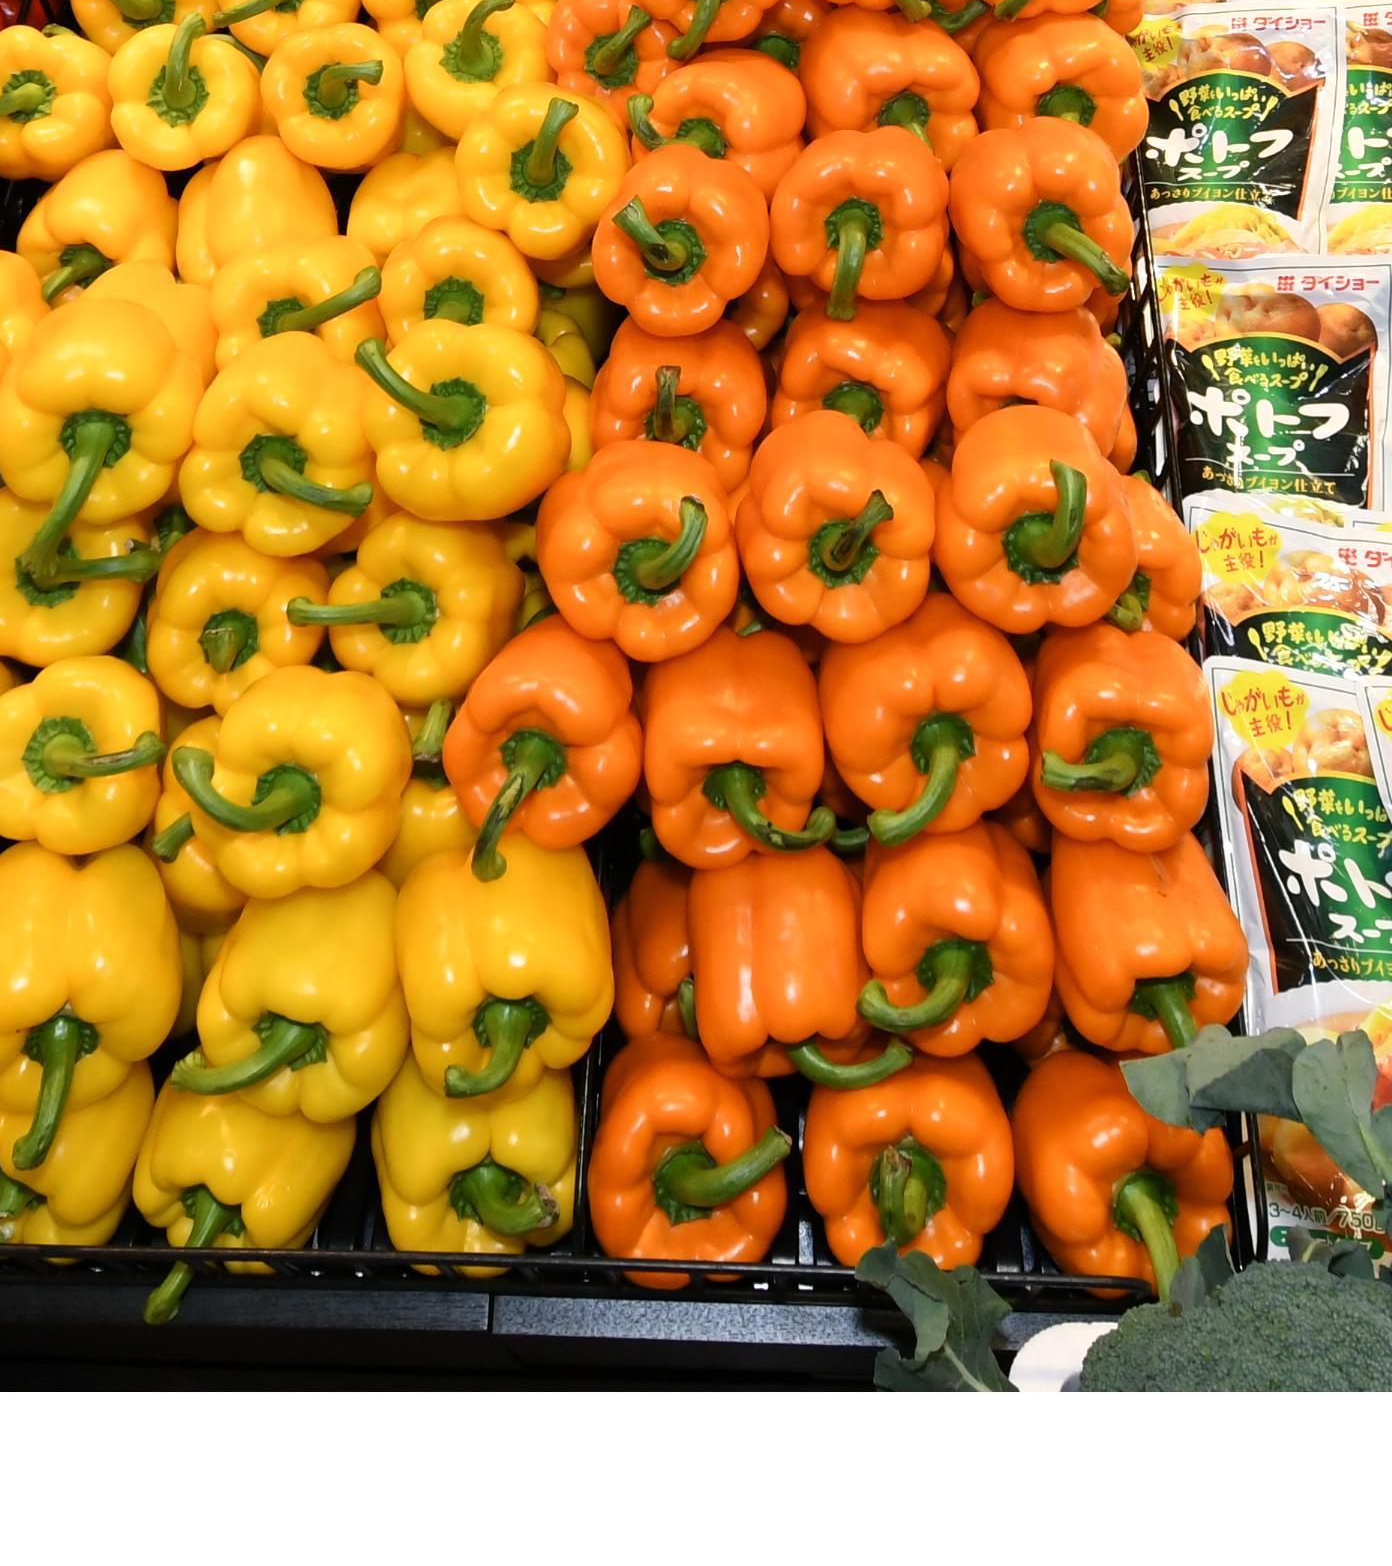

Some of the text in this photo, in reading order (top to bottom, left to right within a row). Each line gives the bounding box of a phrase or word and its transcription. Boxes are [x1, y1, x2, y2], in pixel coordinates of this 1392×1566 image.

[1253, 17, 1326, 31] ダイショー
[1142, 36, 1173, 62] 主役!
[1145, 122, 1294, 168] ポトフ
[1177, 160, 1250, 181] スープ
[1301, 275, 1380, 291] ダイショー
[1186, 386, 1350, 440] ポトフ
[1223, 552, 1265, 573] 主役!
[1250, 712, 1293, 738] 主役!
